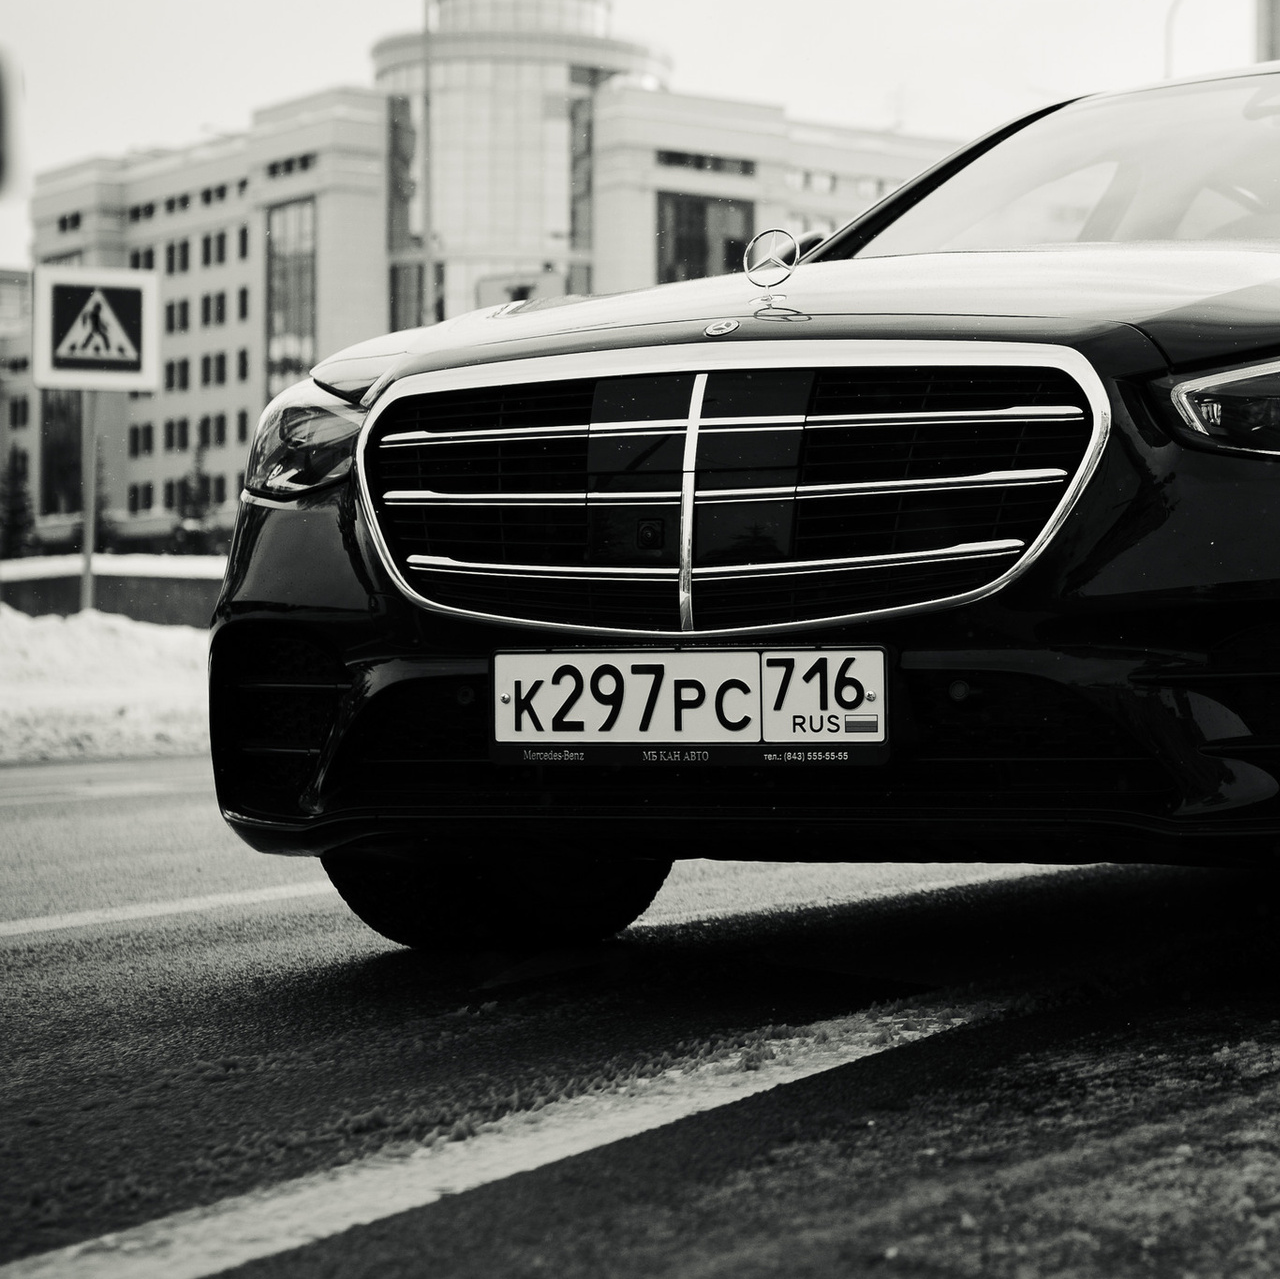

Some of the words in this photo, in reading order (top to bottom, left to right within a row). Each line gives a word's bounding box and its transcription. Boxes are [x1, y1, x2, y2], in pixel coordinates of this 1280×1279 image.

[514, 663, 752, 733] К297РС
[766, 657, 866, 712] 716
[792, 714, 841, 734] RUS
[523, 749, 585, 761] Mercedes-Benz
[659, 751, 681, 762] КАН
[683, 751, 710, 762] АВТО
[783, 751, 805, 762] (843)
[806, 751, 849, 761] 555-55-55
